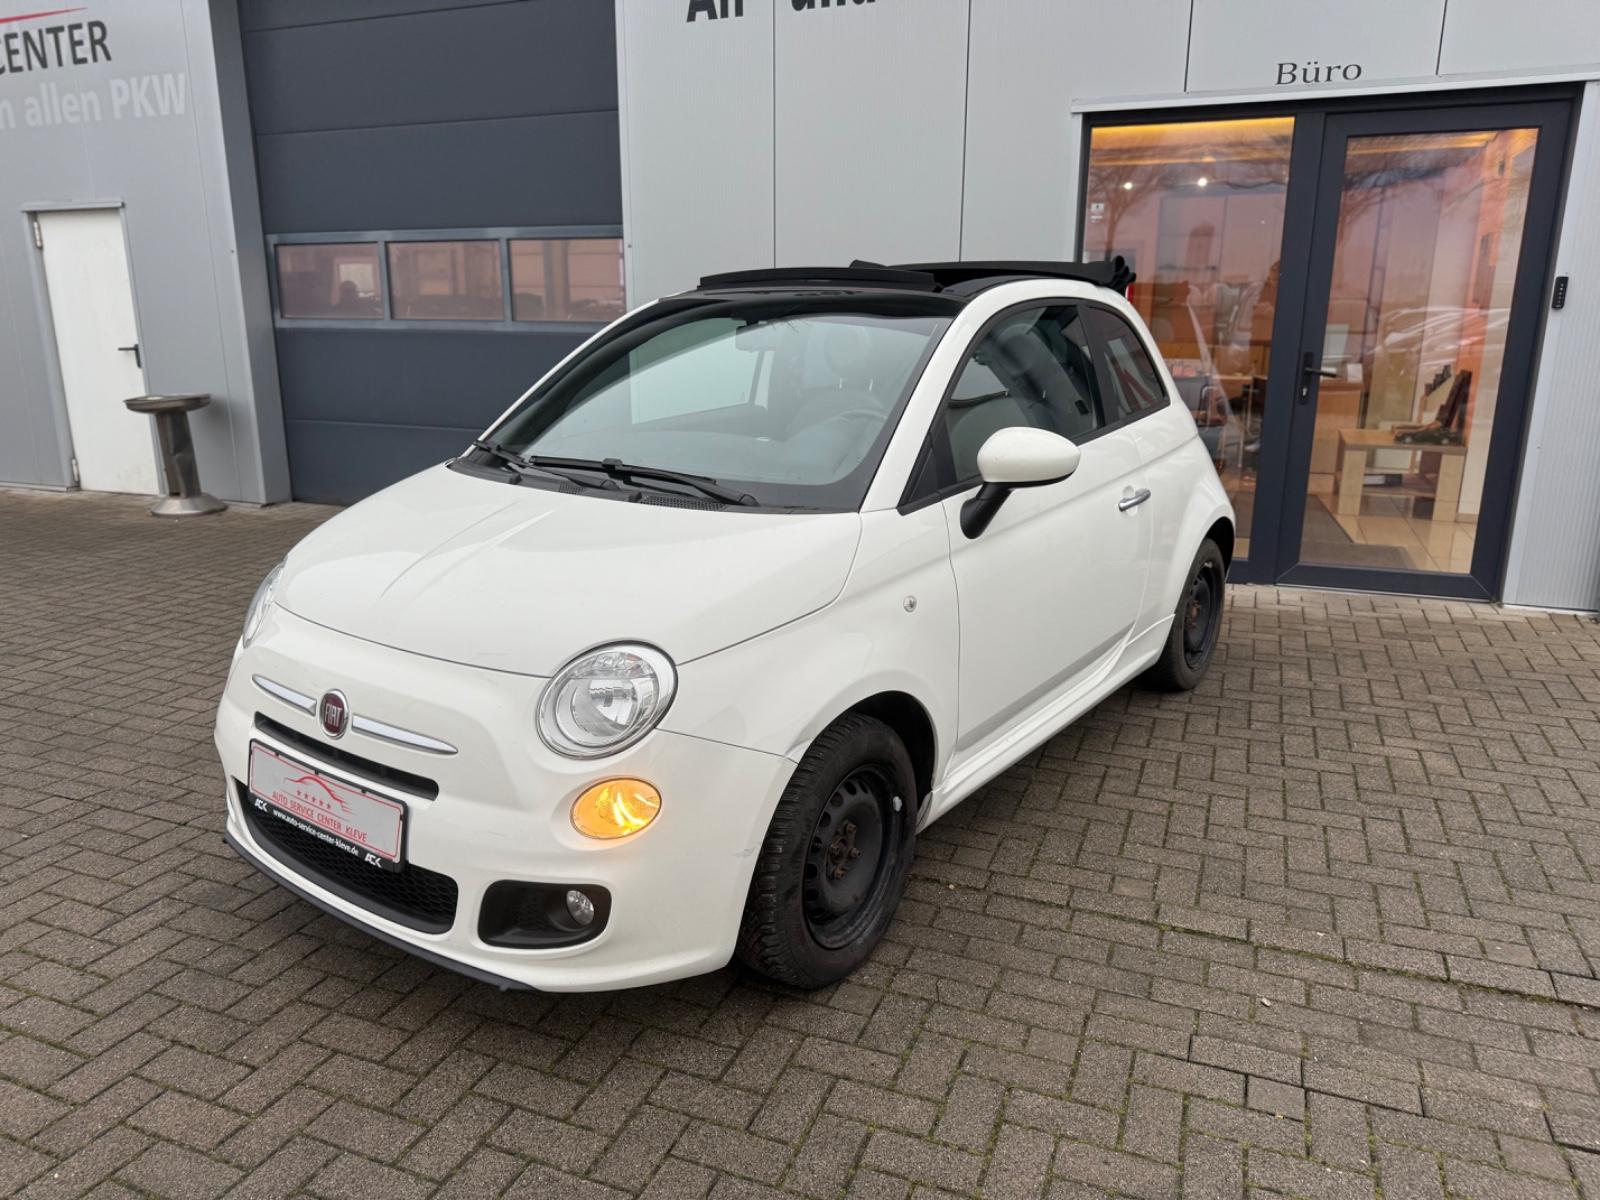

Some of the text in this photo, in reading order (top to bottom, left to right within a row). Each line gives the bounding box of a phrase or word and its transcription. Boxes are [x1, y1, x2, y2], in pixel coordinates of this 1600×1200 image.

[1275, 61, 1362, 85] Büro
[24, 81, 101, 127] allen
[109, 72, 186, 120] PKW
[324, 703, 343, 727] FIAT
[271, 790, 367, 842] AUTO SERVICE CENTER KLEVE
[272, 809, 359, 856] www.auto-service-center-kleve.de
